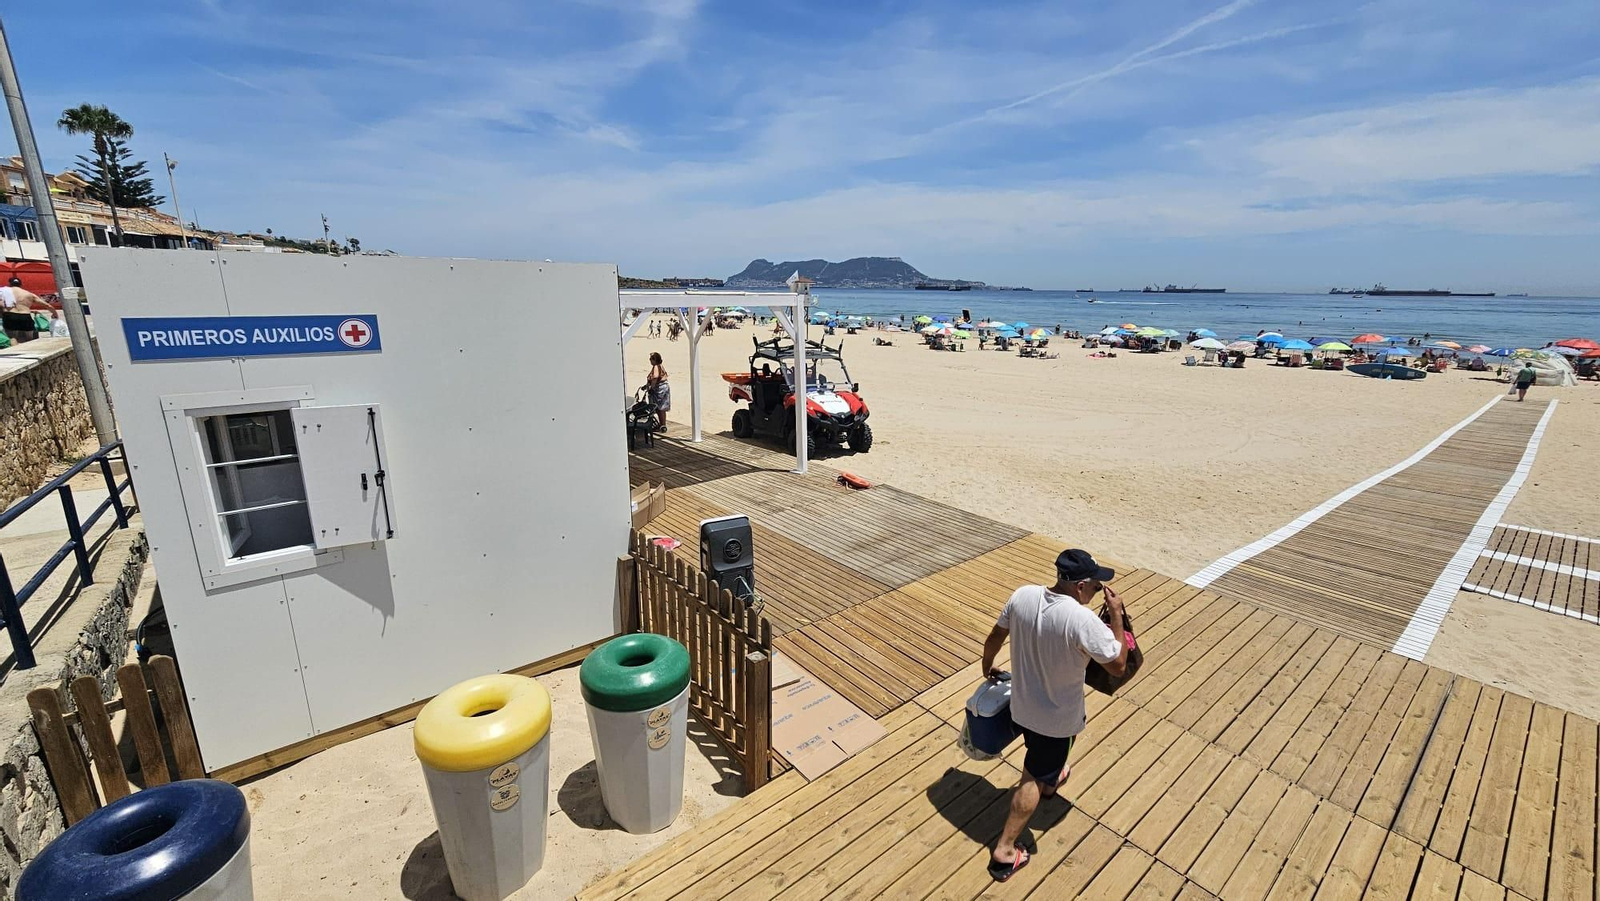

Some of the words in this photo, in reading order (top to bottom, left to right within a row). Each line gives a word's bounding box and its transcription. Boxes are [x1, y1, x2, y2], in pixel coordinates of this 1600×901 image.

[138, 328, 248, 347] PRIMEROS
[252, 327, 335, 344] AUXILIOS
[492, 771, 518, 784] PLAYAS
